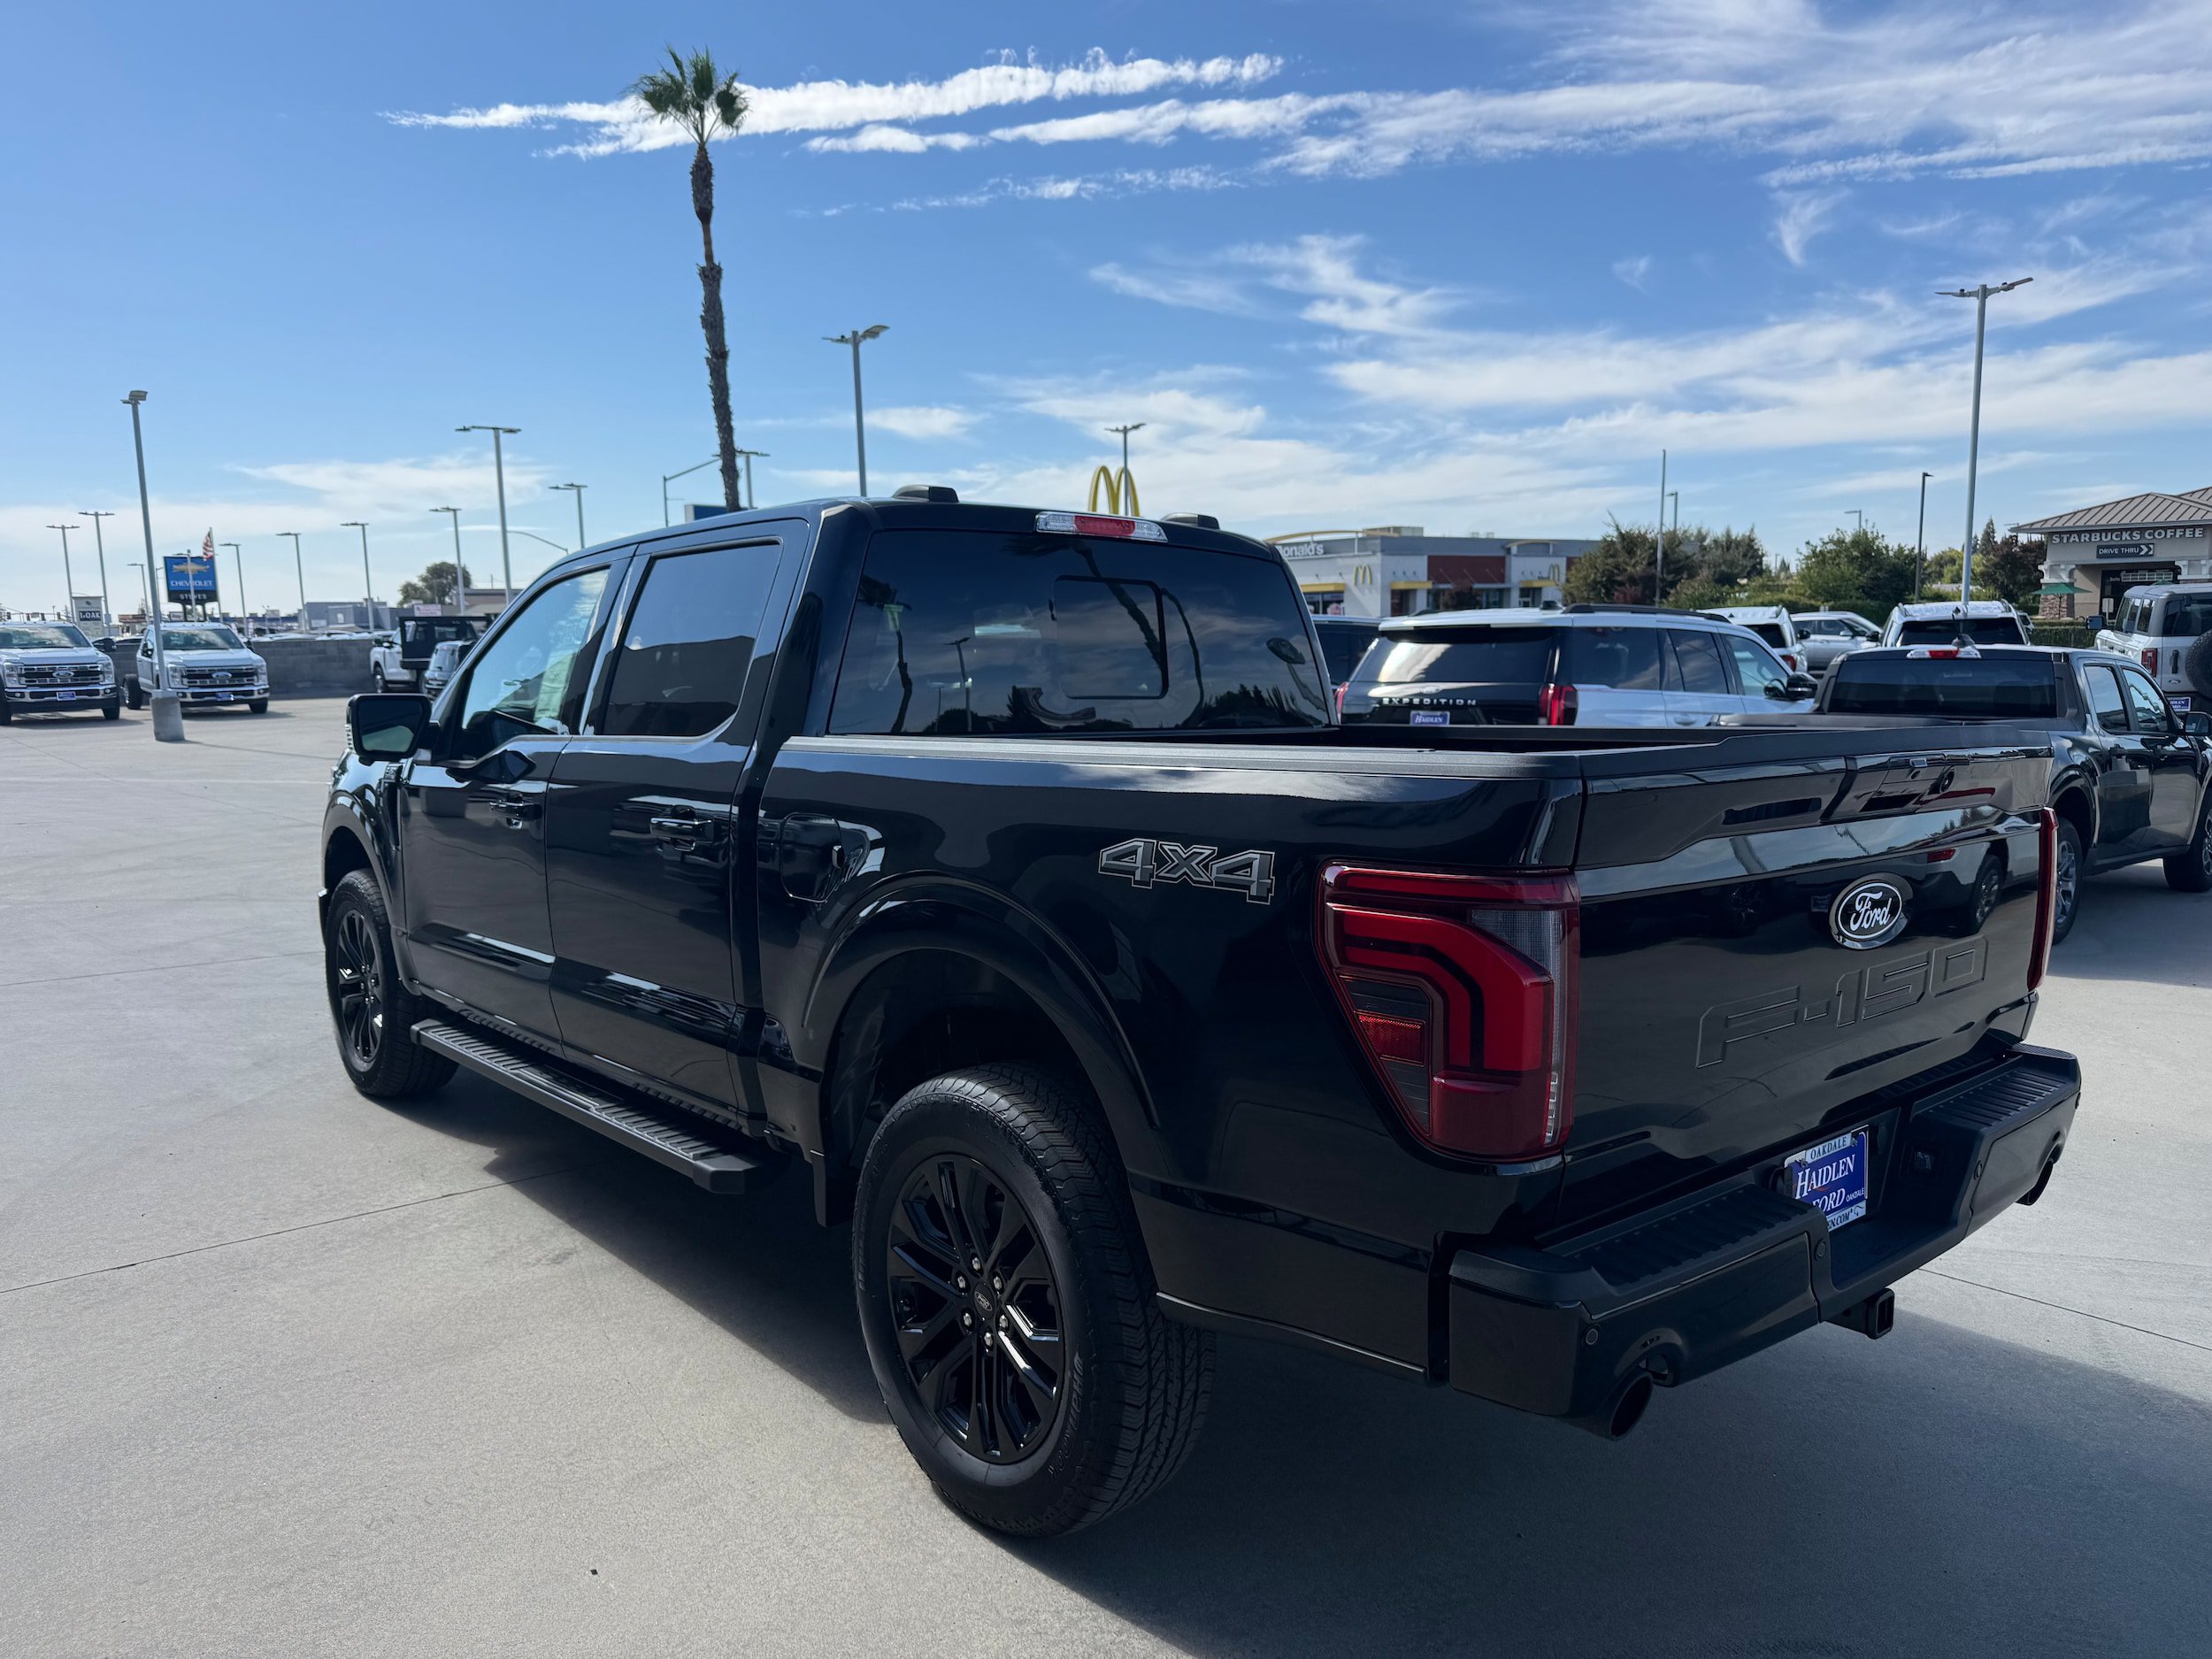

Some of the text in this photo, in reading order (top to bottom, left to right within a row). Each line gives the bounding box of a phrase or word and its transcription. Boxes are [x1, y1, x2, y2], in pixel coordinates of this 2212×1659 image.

[2052, 527, 2204, 544] STARBUCKS COFFEE
[1382, 696, 1477, 706] EXPEDITION
[1849, 891, 1892, 932] Ford
[1696, 934, 1988, 1069] F-150
[1810, 1136, 1847, 1160] OAKDALE
[1794, 1154, 1855, 1200] HAIDLEN
[1846, 1187, 1864, 1202] OAKDALE
